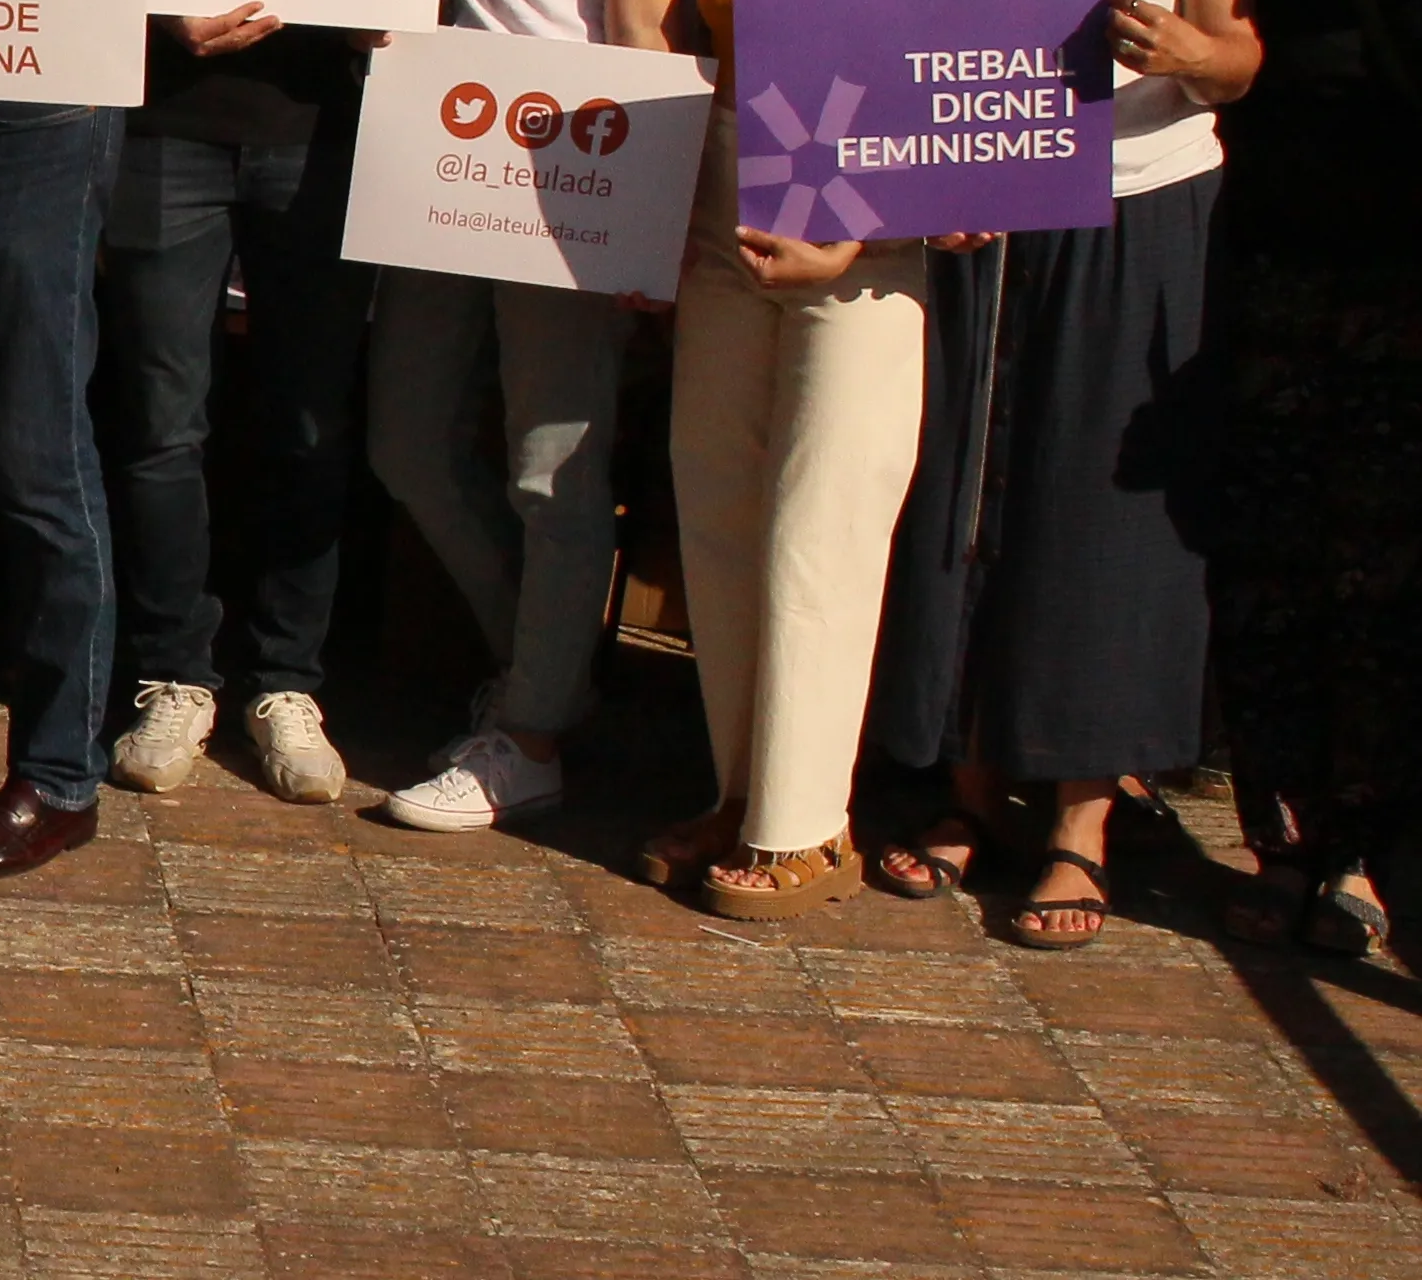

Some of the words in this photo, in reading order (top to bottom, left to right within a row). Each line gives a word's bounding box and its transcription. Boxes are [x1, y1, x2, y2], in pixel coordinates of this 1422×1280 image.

[904, 47, 1077, 84] TREBALL
[932, 88, 1055, 124] DIGNE
[1065, 86, 1074, 117] I
[837, 128, 1077, 168] FEMINISMES
[435, 154, 614, 198] @la_teulada
[428, 205, 610, 247] hola@lateulada.cat
